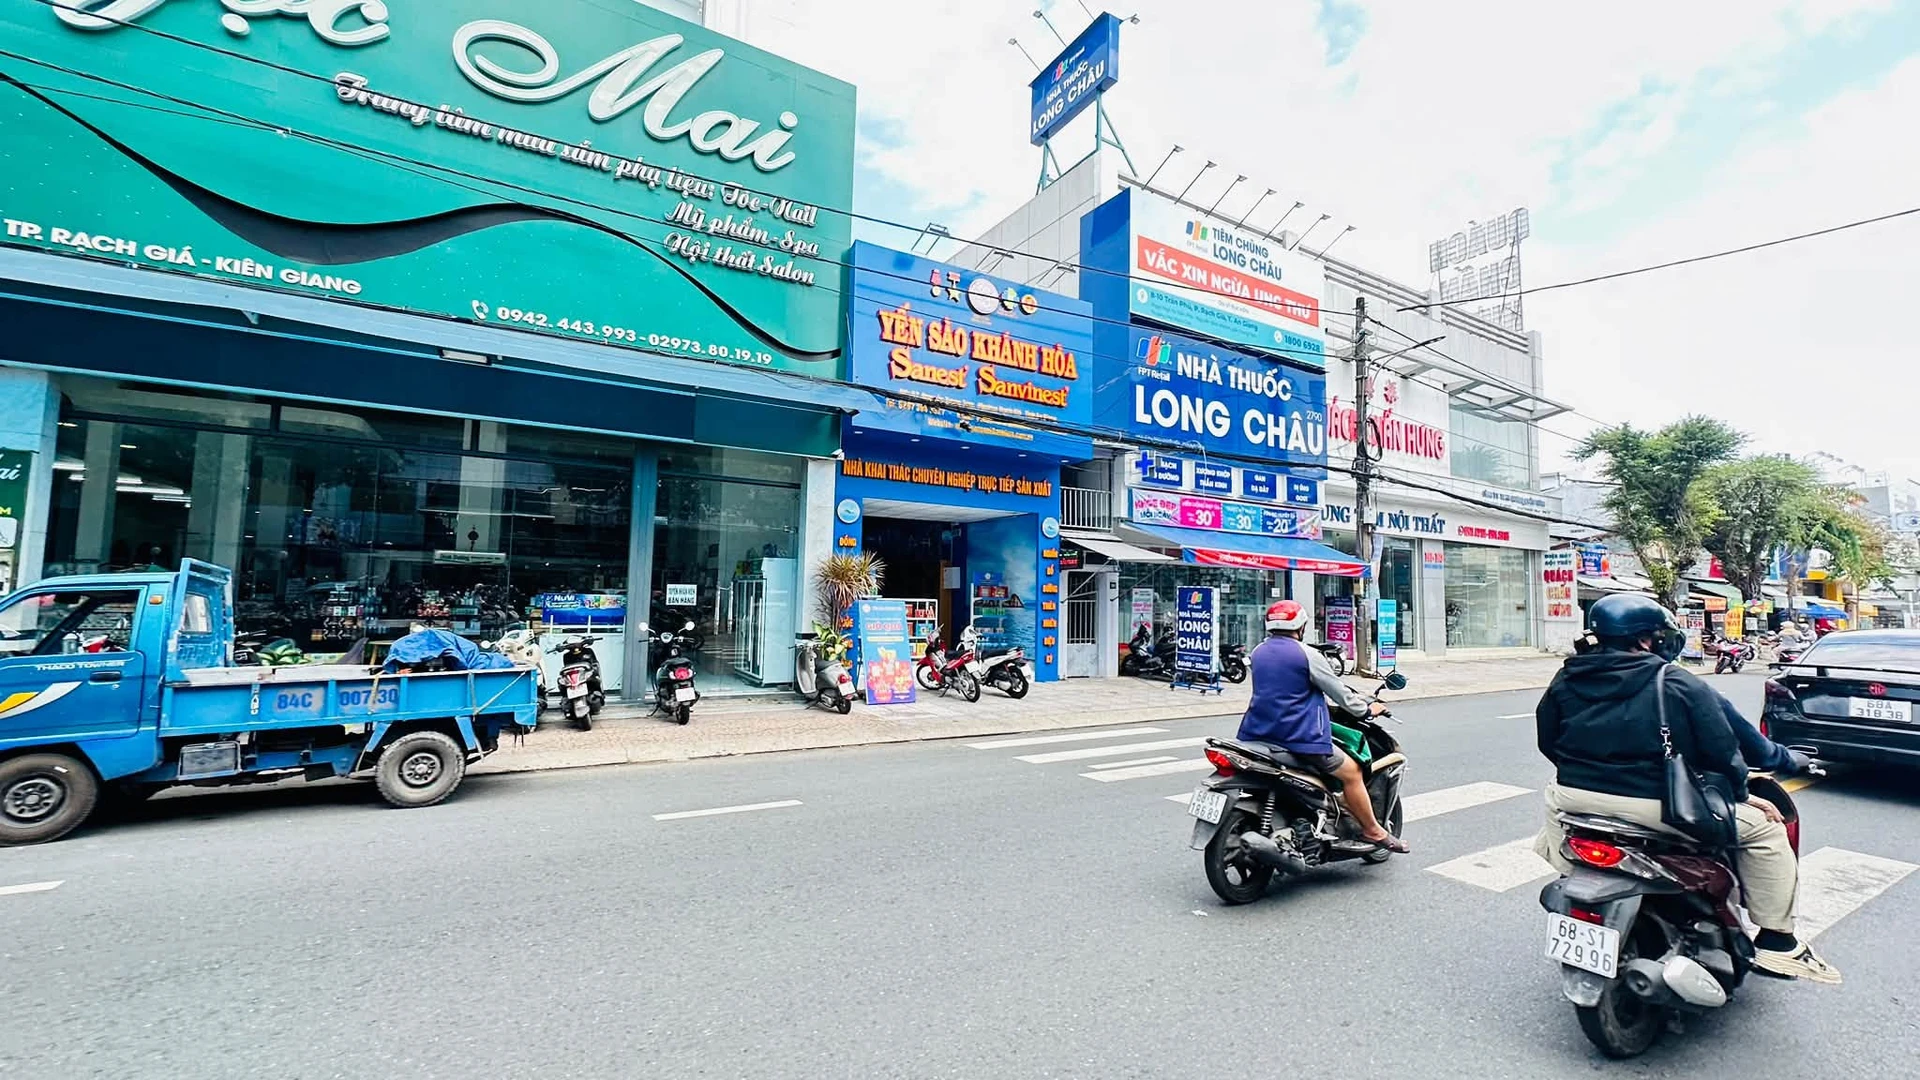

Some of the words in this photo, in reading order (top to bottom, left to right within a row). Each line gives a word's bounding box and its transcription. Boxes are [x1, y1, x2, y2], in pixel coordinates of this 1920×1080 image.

[452, 19, 800, 172] Mai
[1033, 98, 1065, 135] LONG
[1067, 60, 1105, 102] CHÂU
[334, 72, 428, 125] Trung
[434, 106, 493, 139] tâm
[560, 140, 612, 172] sắm
[614, 155, 662, 190] phụ
[1212, 226, 1233, 244] TIÊM
[3, 217, 43, 241] TP.
[51, 226, 136, 256] RẠCH
[143, 245, 196, 267] GIÁ
[214, 256, 273, 281] KIÊN
[279, 267, 362, 295] GIANG
[663, 231, 711, 265] Nội
[713, 243, 756, 273] thất
[758, 257, 816, 286] Salon
[1213, 242, 1246, 268] LONG
[1249, 258, 1282, 281] CHÂU
[1144, 248, 1177, 275] VẮC
[1182, 264, 1207, 285] XIN
[1211, 273, 1250, 298] NGỪA
[1254, 289, 1283, 311] UNG
[1284, 299, 1312, 319] THƯ
[877, 302, 923, 348] YẾN
[927, 316, 968, 357] SÀO
[970, 331, 1038, 372] KHÁNH
[1039, 344, 1079, 379] HÒA
[1284, 335, 1301, 347] 1800
[1137, 366, 1150, 377] FPT
[1177, 352, 1223, 386] NHÀ
[1227, 366, 1293, 401] THUỐC
[1135, 384, 1231, 438] LONG
[1243, 408, 1324, 456] CHÂU
[1306, 410, 1323, 422] 2790
[843, 458, 863, 477] NHÀ
[865, 463, 886, 478] KHAI
[888, 463, 911, 482] THÁC
[912, 466, 945, 485] CHUYÊN
[947, 470, 976, 493] NGHIỆP
[977, 474, 997, 495] TRỰC
[998, 474, 1015, 494] TIẾP
[1016, 478, 1032, 495] SẢN
[1033, 478, 1052, 497] XUẤT
[1388, 510, 1410, 532] NỘI
[1413, 512, 1446, 533] THẤT
[1178, 636, 1210, 651] CHÂU
[1179, 621, 1210, 633] LONG
[277, 692, 315, 710] 84C
[1867, 700, 1892, 710] 68A
